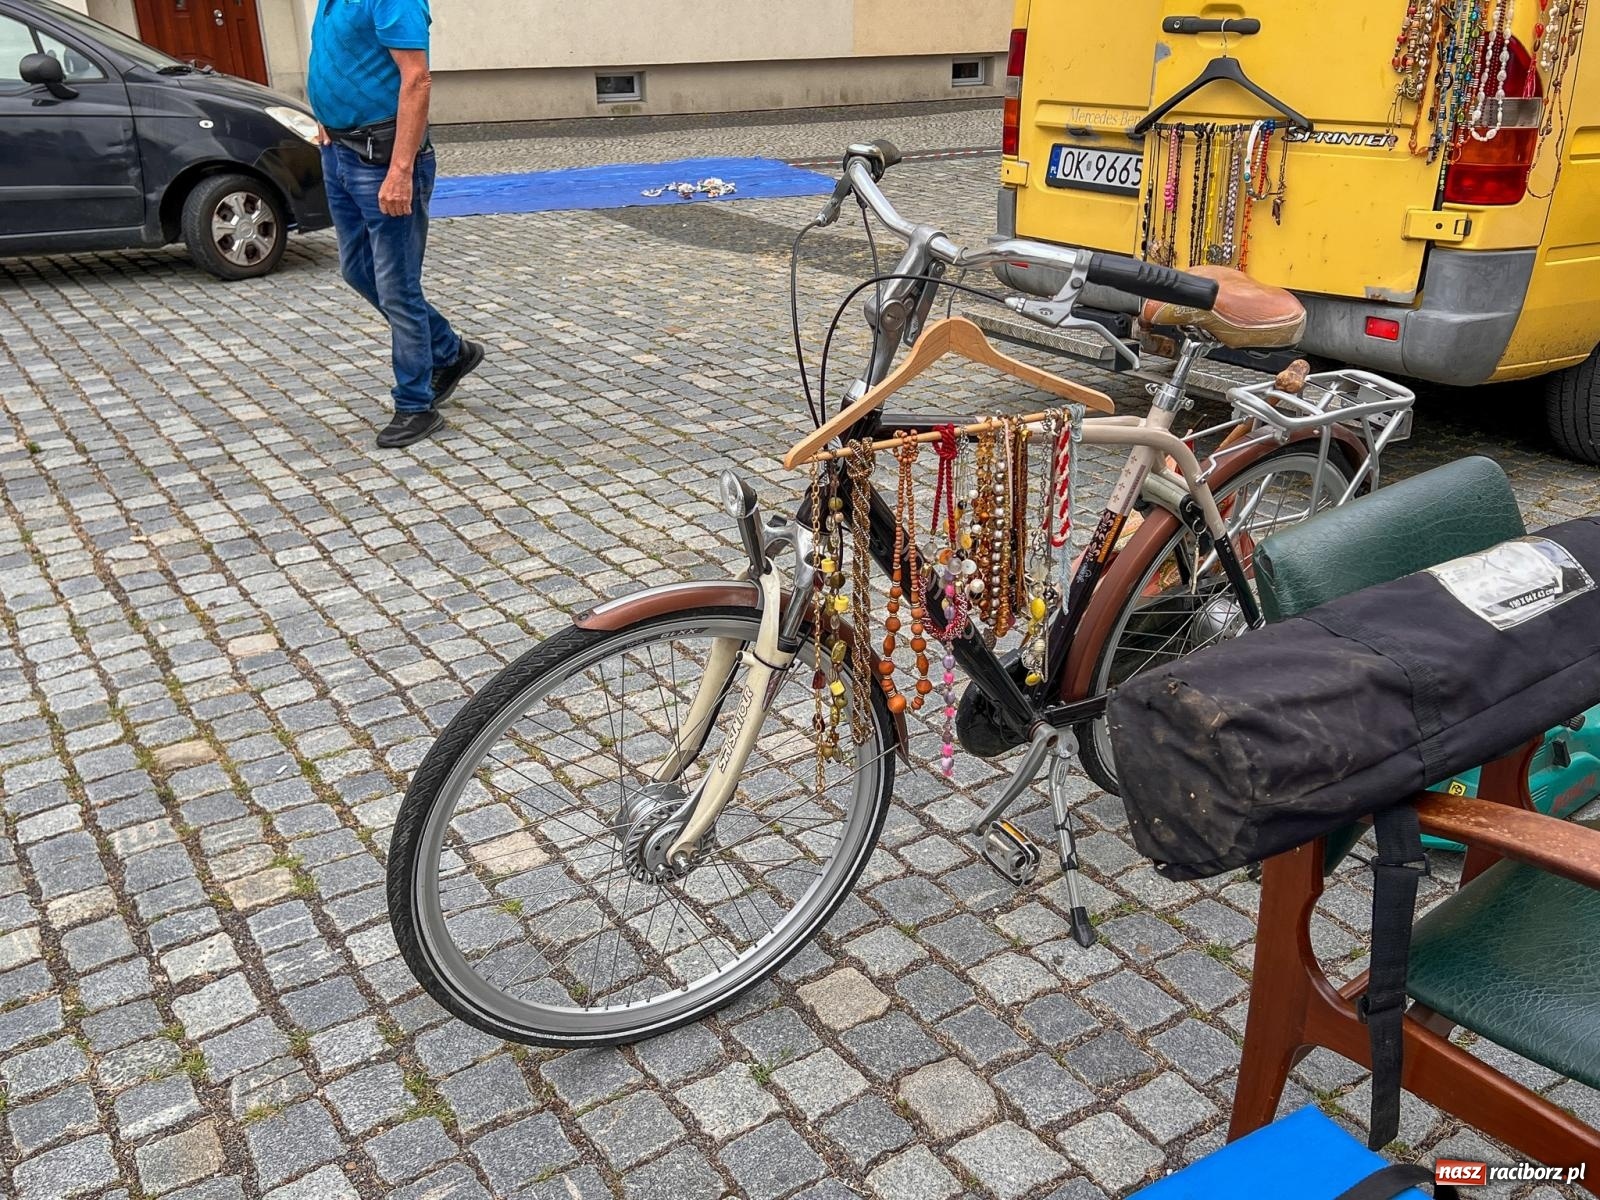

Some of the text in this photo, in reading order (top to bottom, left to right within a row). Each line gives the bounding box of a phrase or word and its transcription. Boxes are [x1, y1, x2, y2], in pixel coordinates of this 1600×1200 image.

[1070, 108, 1143, 126] Mercedes-Ben
[1281, 126, 1397, 147] SPRINTER
[1062, 151, 1143, 186] OK 9665
